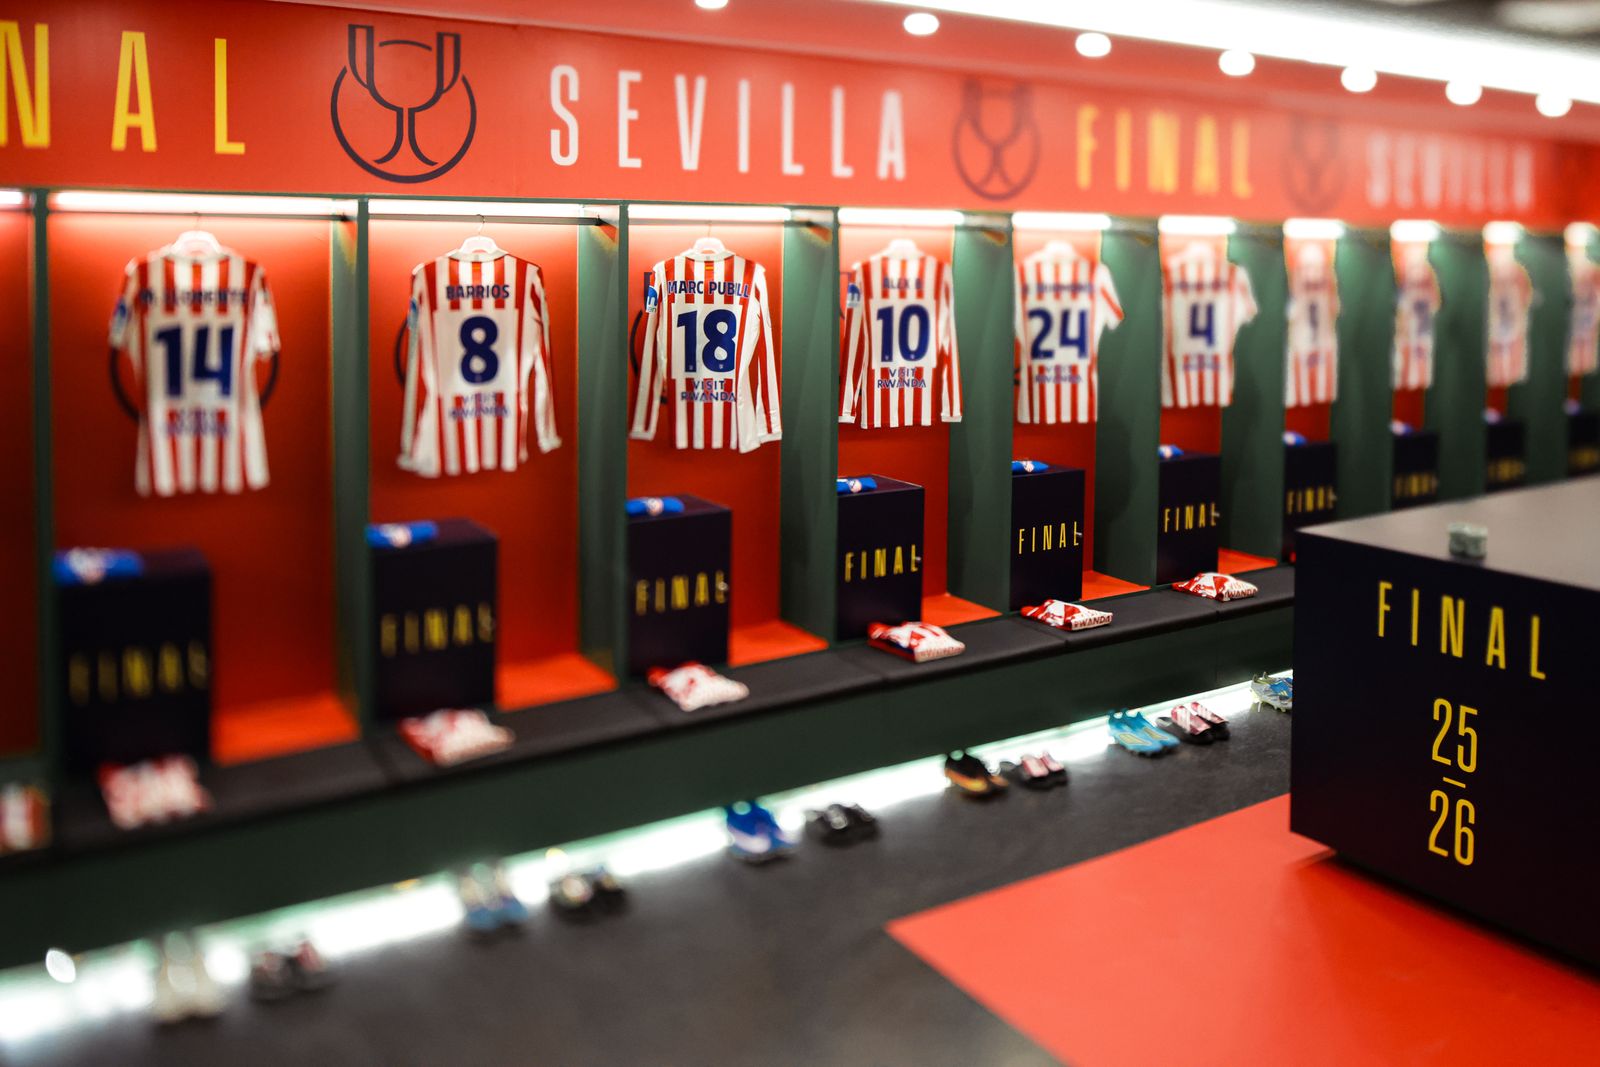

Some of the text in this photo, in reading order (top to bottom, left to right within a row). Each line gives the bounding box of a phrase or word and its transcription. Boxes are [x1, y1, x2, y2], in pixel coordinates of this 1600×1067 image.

[550, 65, 905, 180] SEVILLA
[1076, 104, 1252, 198] FINAL
[446, 284, 510, 300] BARRIOS
[668, 281, 704, 295] MARC
[676, 309, 737, 373] 18
[877, 304, 930, 363] 10
[1027, 307, 1089, 360] 24
[1189, 302, 1215, 348] 4
[155, 324, 235, 396] 14
[460, 316, 499, 384] 8
[681, 391, 737, 402] RWANDA
[693, 380, 725, 390] VISIT
[877, 379, 927, 389] RWANDA
[1018, 521, 1079, 554] FINAL
[1164, 503, 1217, 533] FINAL
[845, 544, 918, 582] FINAL
[1378, 581, 1546, 681] FINAL
[1432, 697, 1478, 773] 25
[1428, 789, 1476, 866] 26
